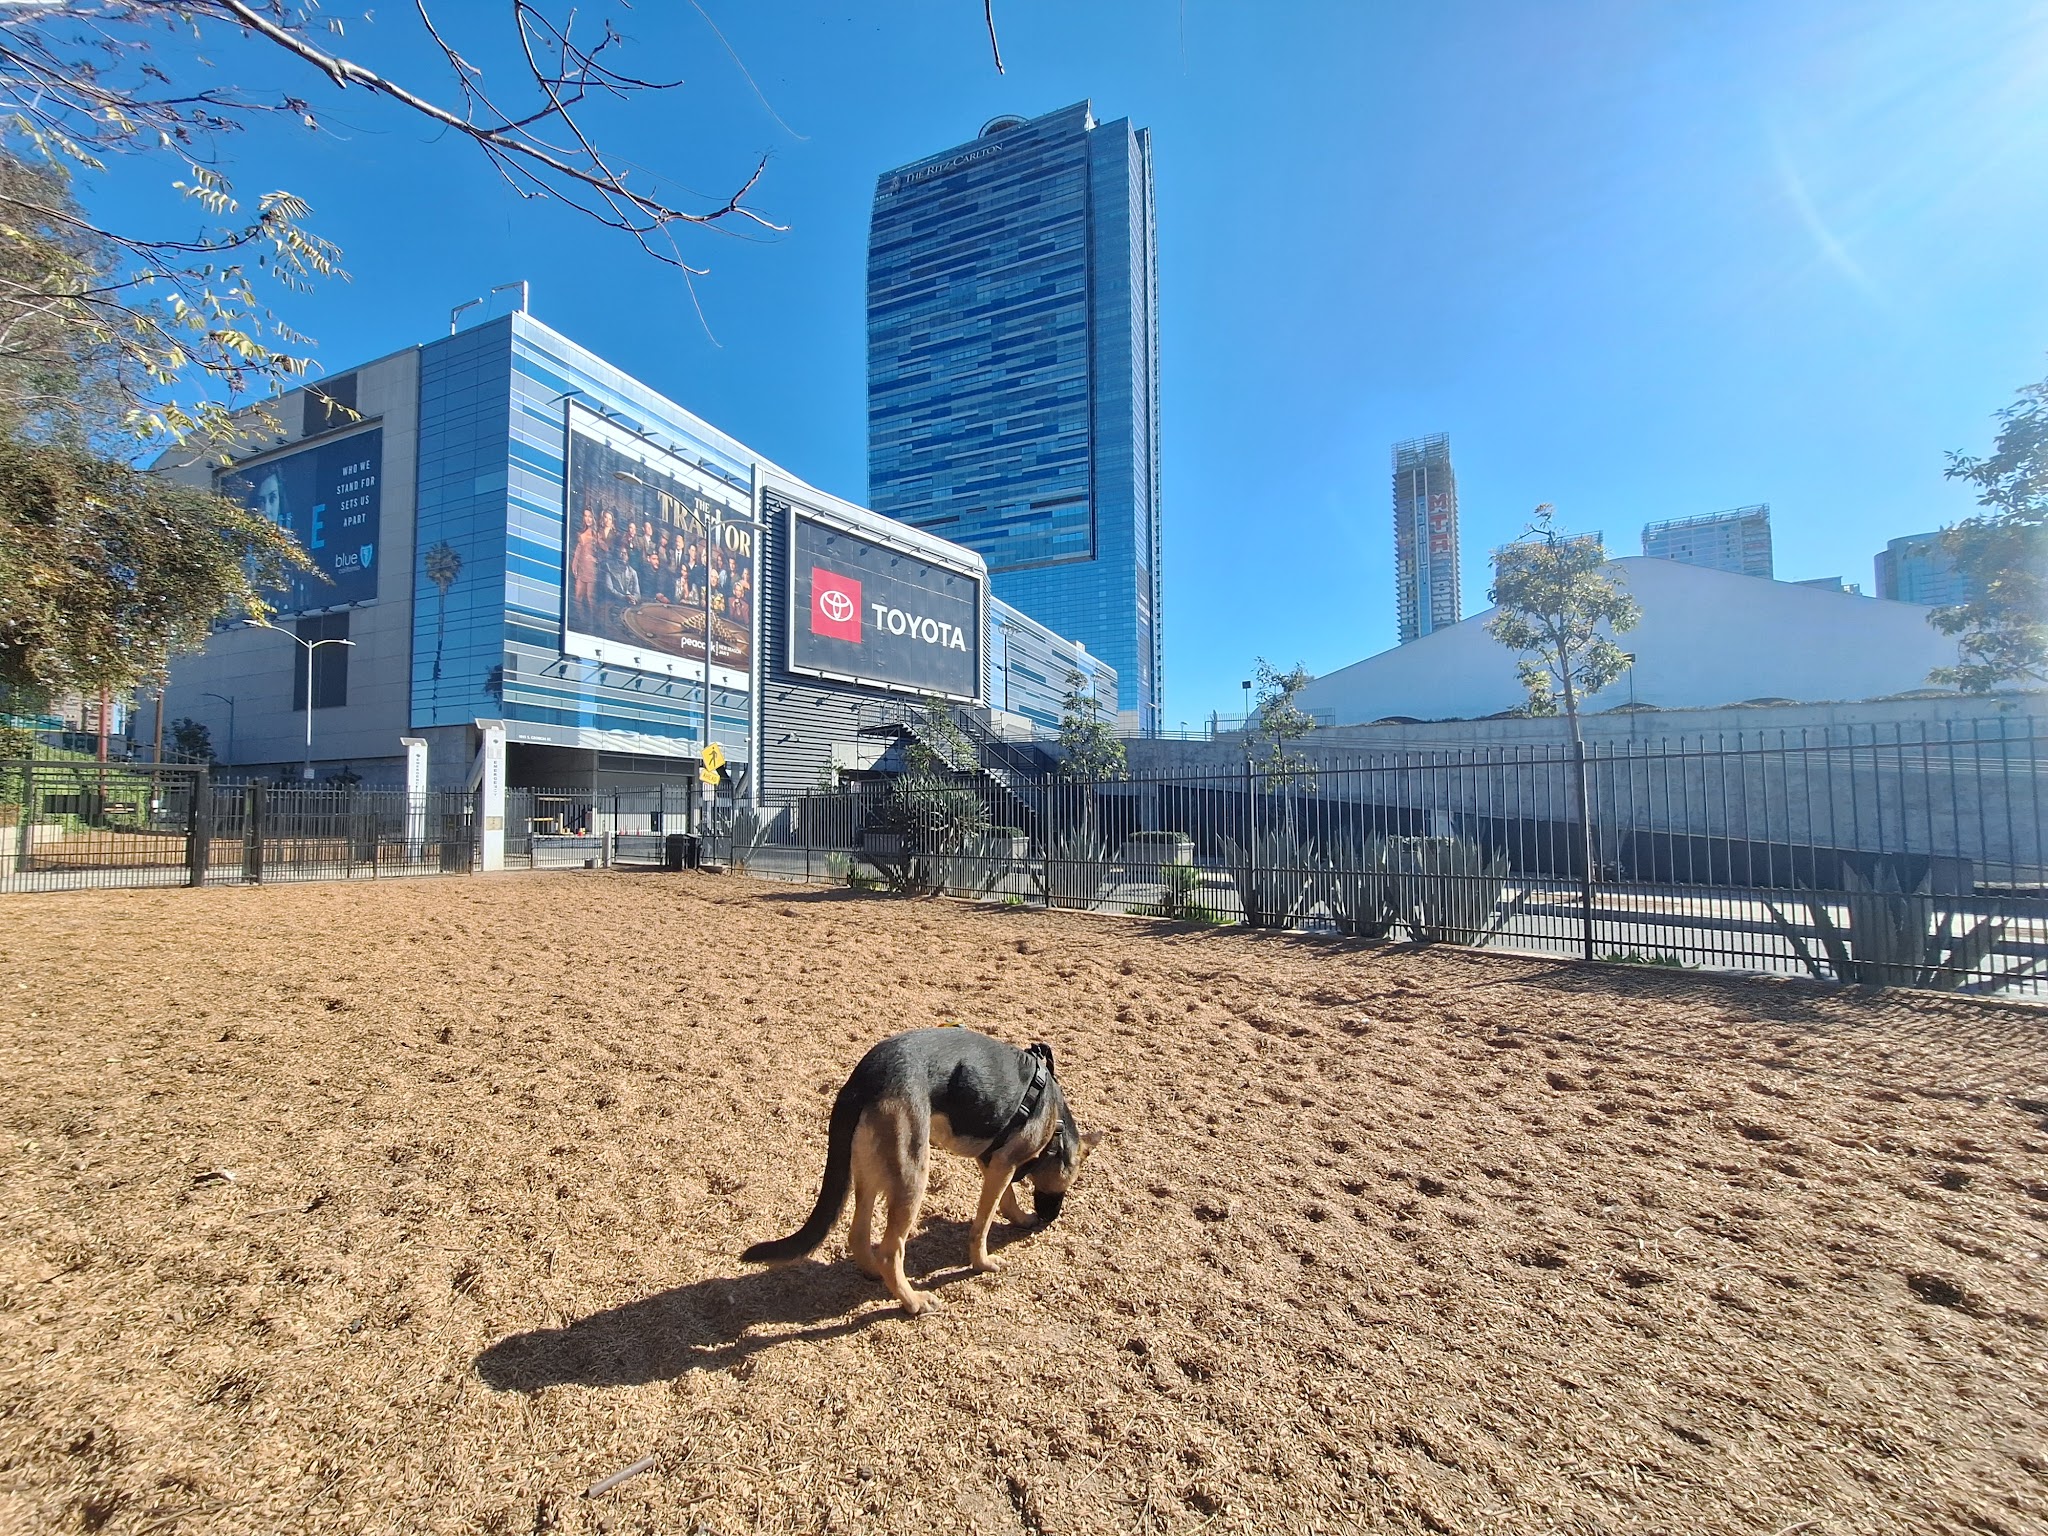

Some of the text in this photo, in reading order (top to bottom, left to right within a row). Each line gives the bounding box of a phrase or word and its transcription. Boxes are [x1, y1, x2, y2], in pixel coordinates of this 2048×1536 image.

[905, 142, 1004, 183] THE RITZ-CARLTON
[342, 459, 371, 476] WHO WE
[336, 477, 375, 495] STAND FOR
[340, 494, 370, 511] SETS US
[694, 496, 711, 514] THE
[343, 512, 367, 527] APART
[335, 551, 358, 568] blue
[871, 602, 967, 652] TOYOTA
[680, 636, 716, 652] peacok
[702, 772, 718, 783] AHEAD
